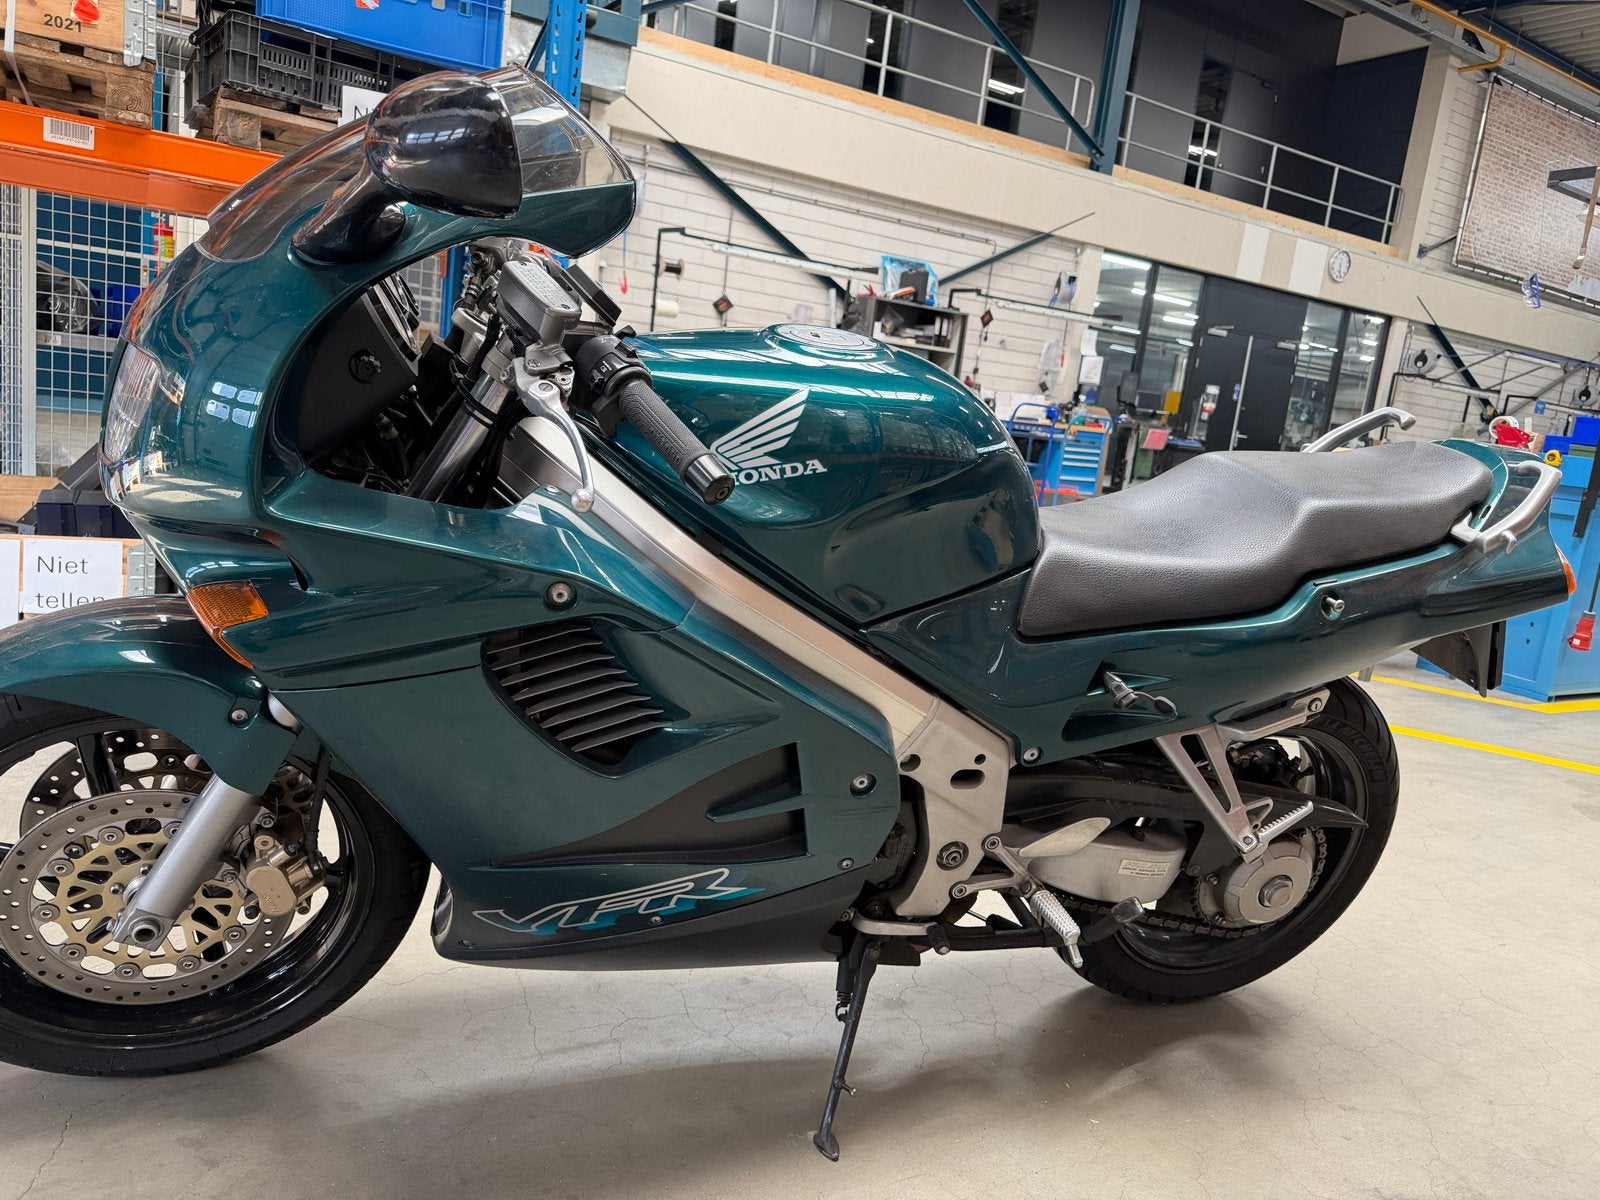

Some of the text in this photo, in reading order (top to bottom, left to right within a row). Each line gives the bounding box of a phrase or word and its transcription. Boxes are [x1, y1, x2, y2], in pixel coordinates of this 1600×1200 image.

[44, 13, 82, 33] 2021
[37, 555, 89, 575] Niet
[472, 867, 747, 932] VFR
